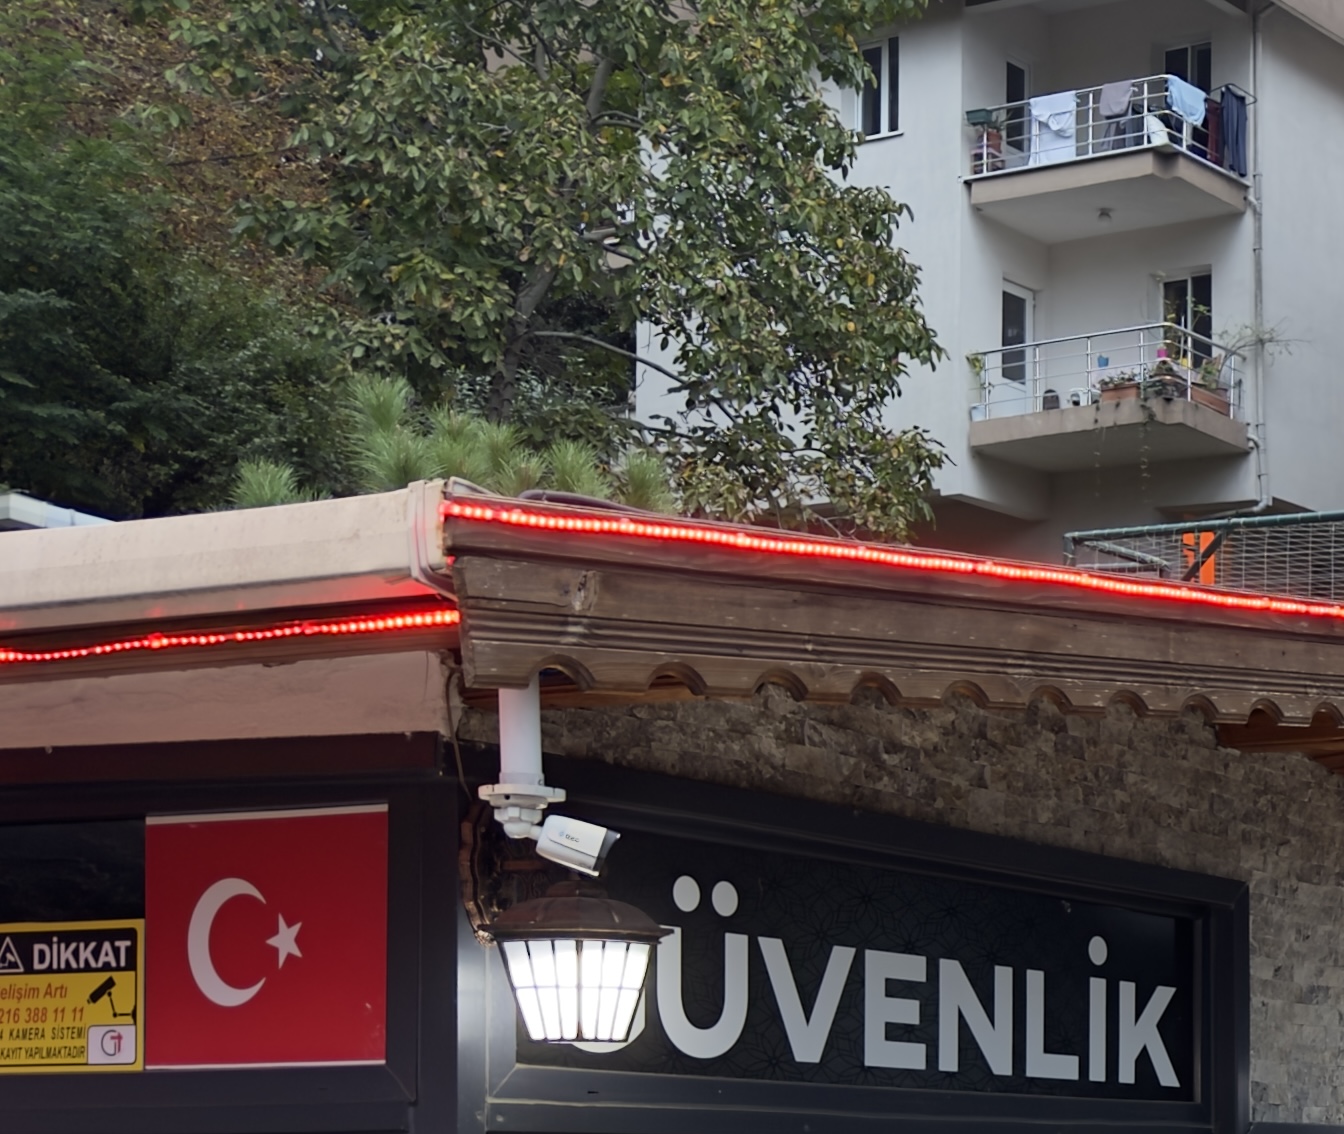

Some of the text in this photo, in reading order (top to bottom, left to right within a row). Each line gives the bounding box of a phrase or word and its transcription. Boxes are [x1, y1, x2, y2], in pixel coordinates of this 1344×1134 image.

[32, 936, 132, 970] DİKKAT
[570, 875, 1181, 1088] ÜVENLİK
[0, 982, 68, 1004] elişim Artı
[24, 1006, 48, 1024] 388
[53, 1006, 66, 1023] 11
[72, 1006, 84, 1022] 11
[9, 1027, 45, 1041] KAMERA
[51, 1024, 86, 1040] SİSTEMİ
